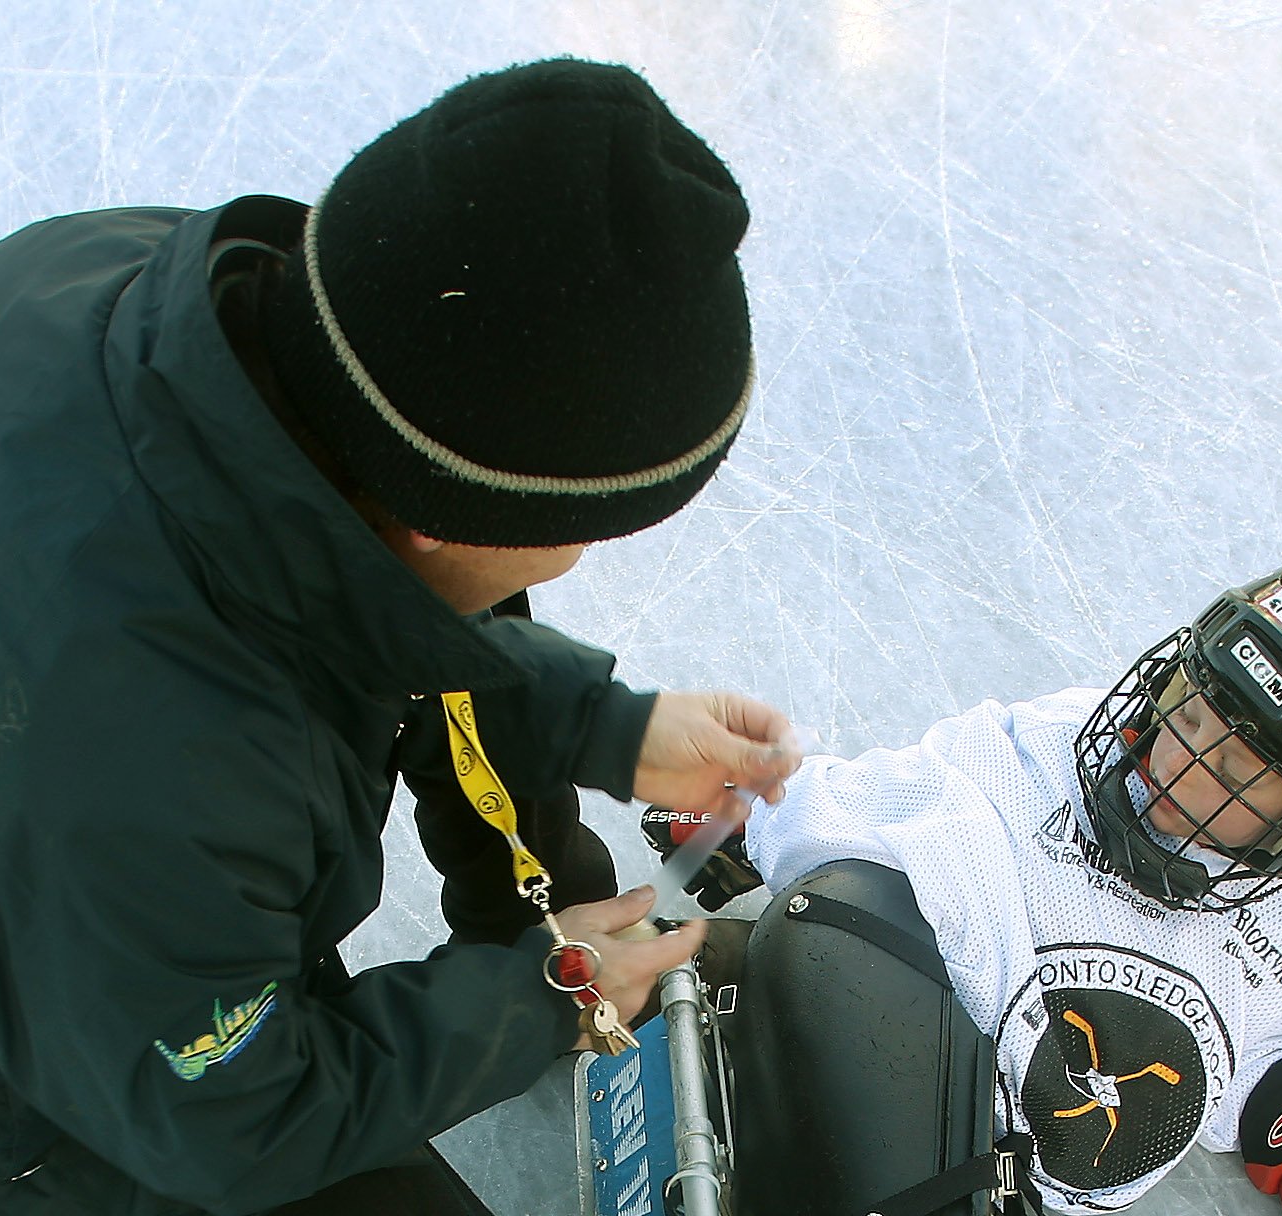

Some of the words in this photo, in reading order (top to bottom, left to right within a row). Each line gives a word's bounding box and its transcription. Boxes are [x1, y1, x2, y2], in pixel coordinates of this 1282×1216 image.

[642, 810, 713, 825] ESPELE
[1106, 880, 1167, 924] Recreation
[1121, 964, 1211, 1033] SLEDGE
